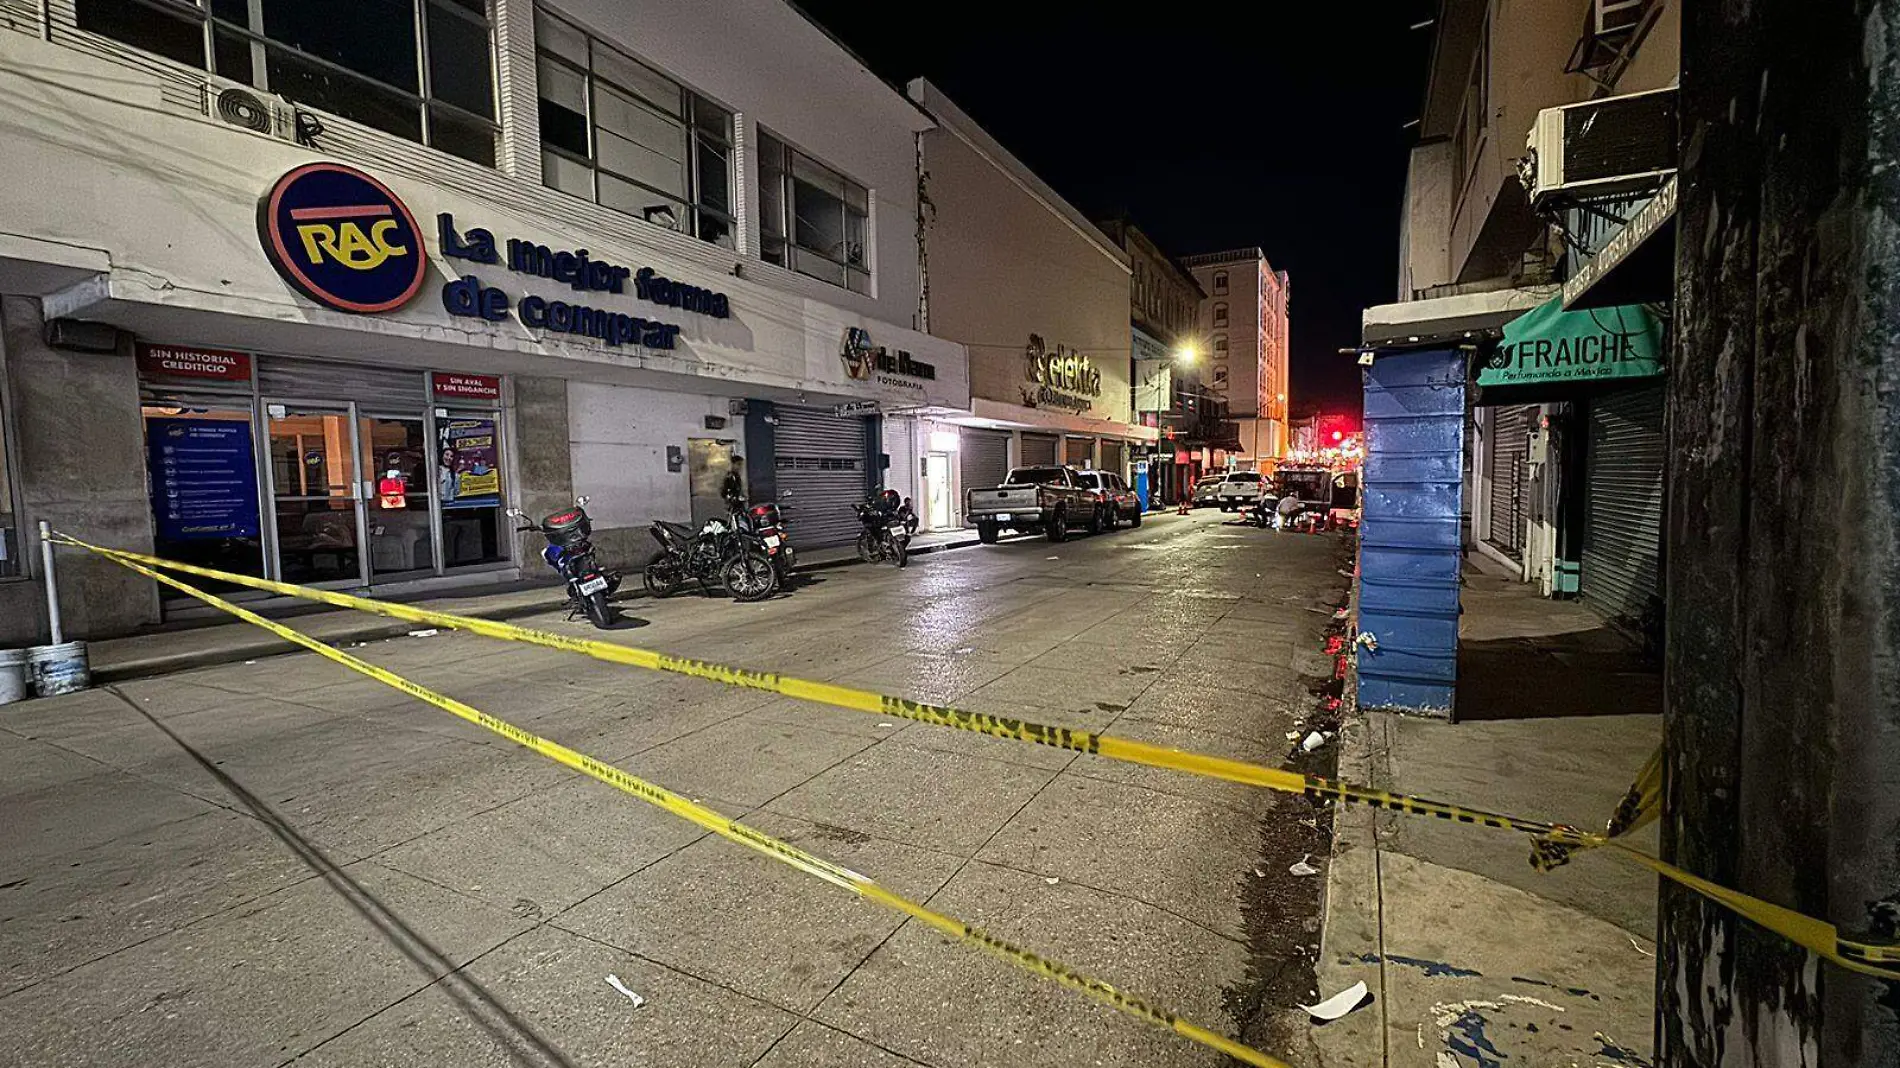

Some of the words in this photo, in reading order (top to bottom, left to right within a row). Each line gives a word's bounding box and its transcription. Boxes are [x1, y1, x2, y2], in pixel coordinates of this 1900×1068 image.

[297, 219, 408, 270] RAC
[437, 212, 496, 264] La
[506, 238, 630, 294] mejor
[634, 267, 730, 318] forma
[442, 275, 509, 321] de
[518, 295, 680, 350] comprar
[150, 349, 171, 359] SIN
[175, 352, 237, 365] HISTORIAL
[162, 360, 227, 373] CREDITICIO
[1518, 333, 1636, 368] FRAICHE
[1502, 369, 1561, 380] Perfumando
